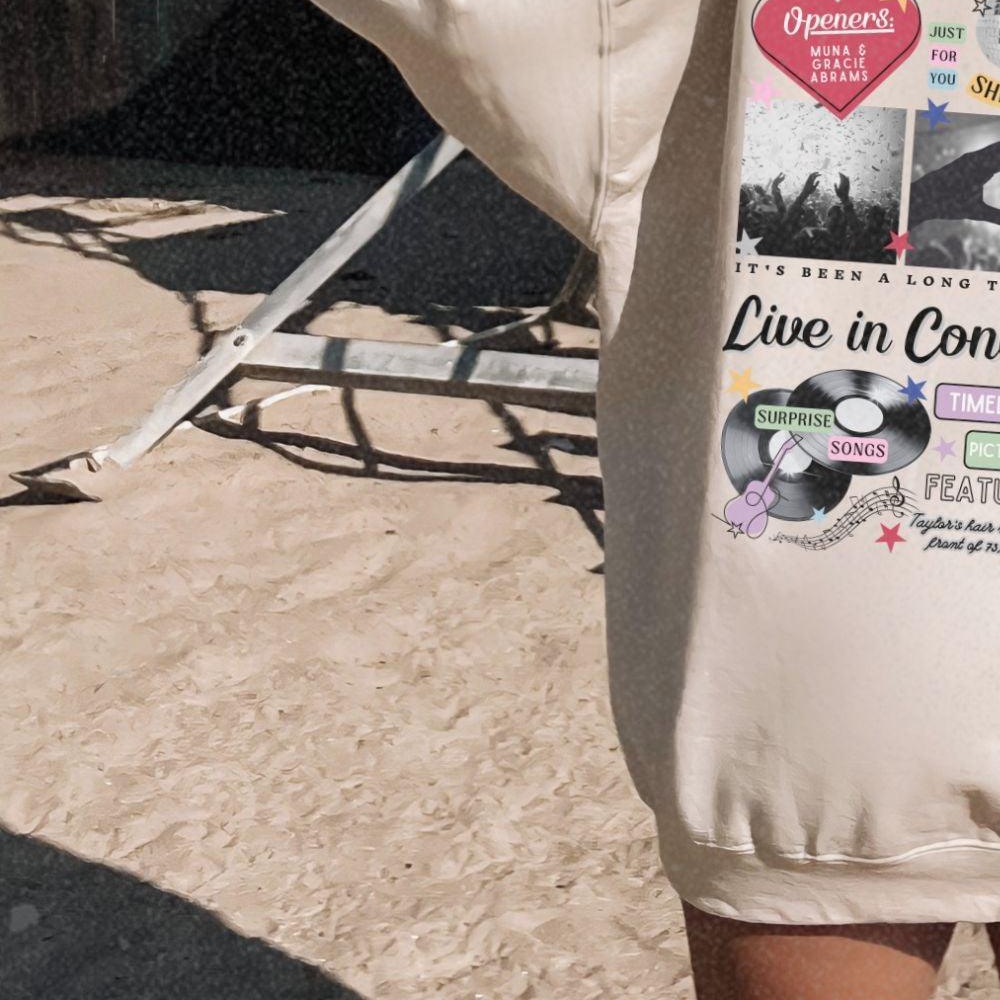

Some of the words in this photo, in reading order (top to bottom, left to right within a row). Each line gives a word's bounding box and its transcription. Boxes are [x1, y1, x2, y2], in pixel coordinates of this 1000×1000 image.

[784, 6, 895, 41] Openers:
[929, 26, 965, 39] JUST
[811, 45, 850, 57] MUNA
[859, 44, 867, 57] &
[931, 49, 957, 62] FOR
[812, 57, 866, 70] GRACIE
[811, 70, 868, 83] ABRAMS
[930, 72, 957, 85] YOU
[735, 262, 785, 276] IT'S
[802, 267, 862, 281] BEEN
[878, 272, 890, 284] A
[907, 275, 971, 289] LONG
[722, 294, 832, 352] Live
[847, 310, 893, 354] in
[757, 409, 832, 428] SURPRISE
[831, 440, 886, 458] SONGS
[910, 512, 962, 535] Taylor's
[965, 519, 994, 534] hair
[923, 536, 966, 551] front
[966, 539, 984, 554] of
